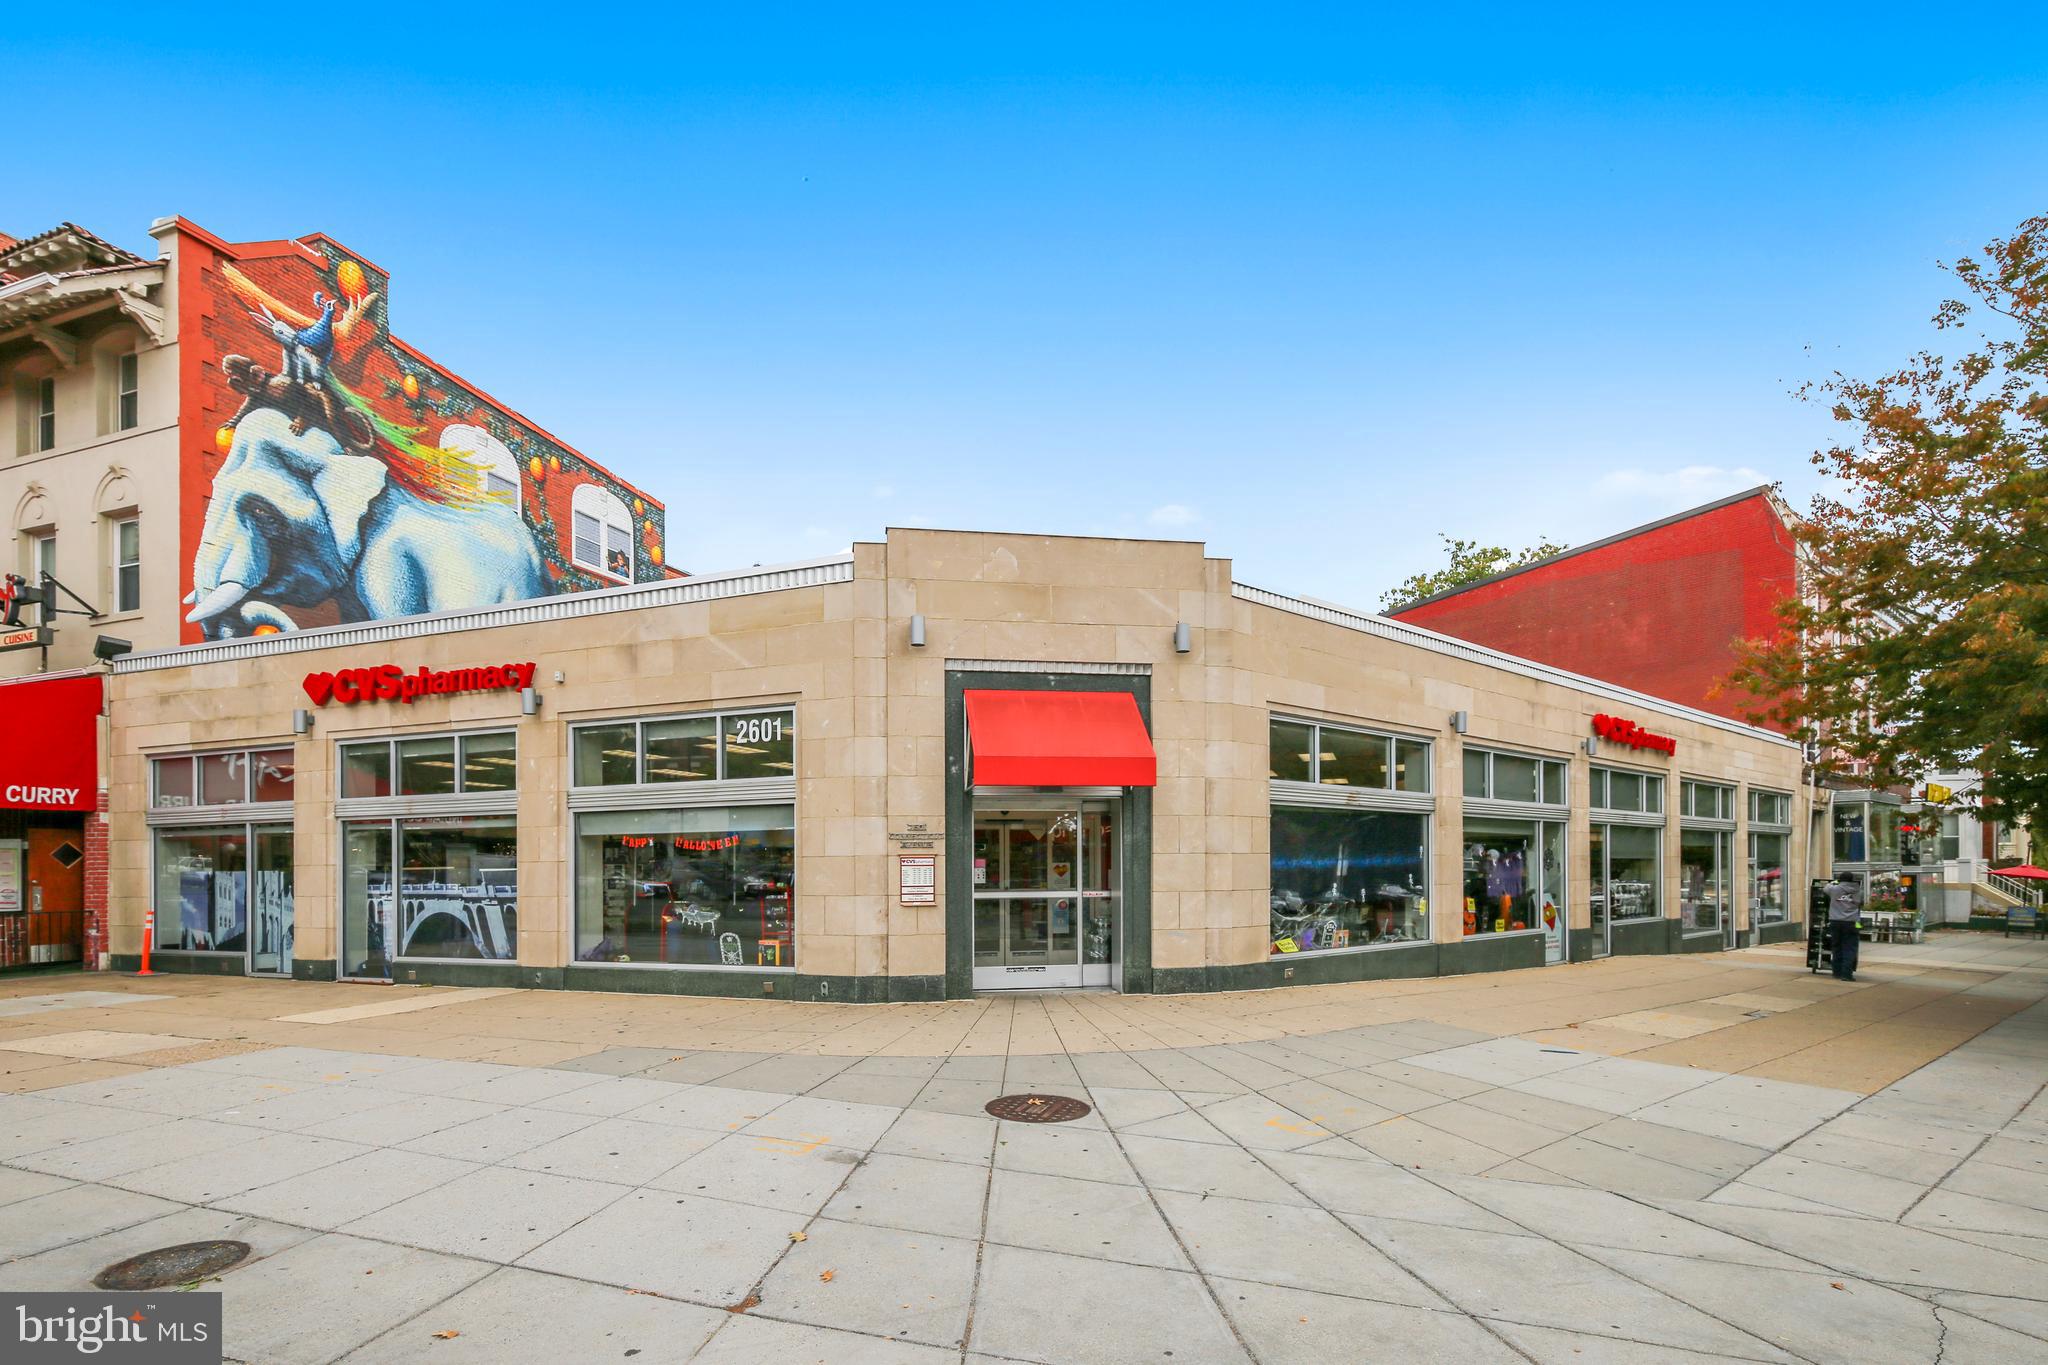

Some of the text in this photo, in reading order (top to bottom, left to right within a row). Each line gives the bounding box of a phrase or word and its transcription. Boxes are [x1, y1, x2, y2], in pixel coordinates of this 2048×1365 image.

[4, 632, 33, 645] CUISINE
[332, 662, 537, 705] CVS pharmacy
[736, 717, 782, 743] 2601
[5, 785, 80, 805] CURRY
